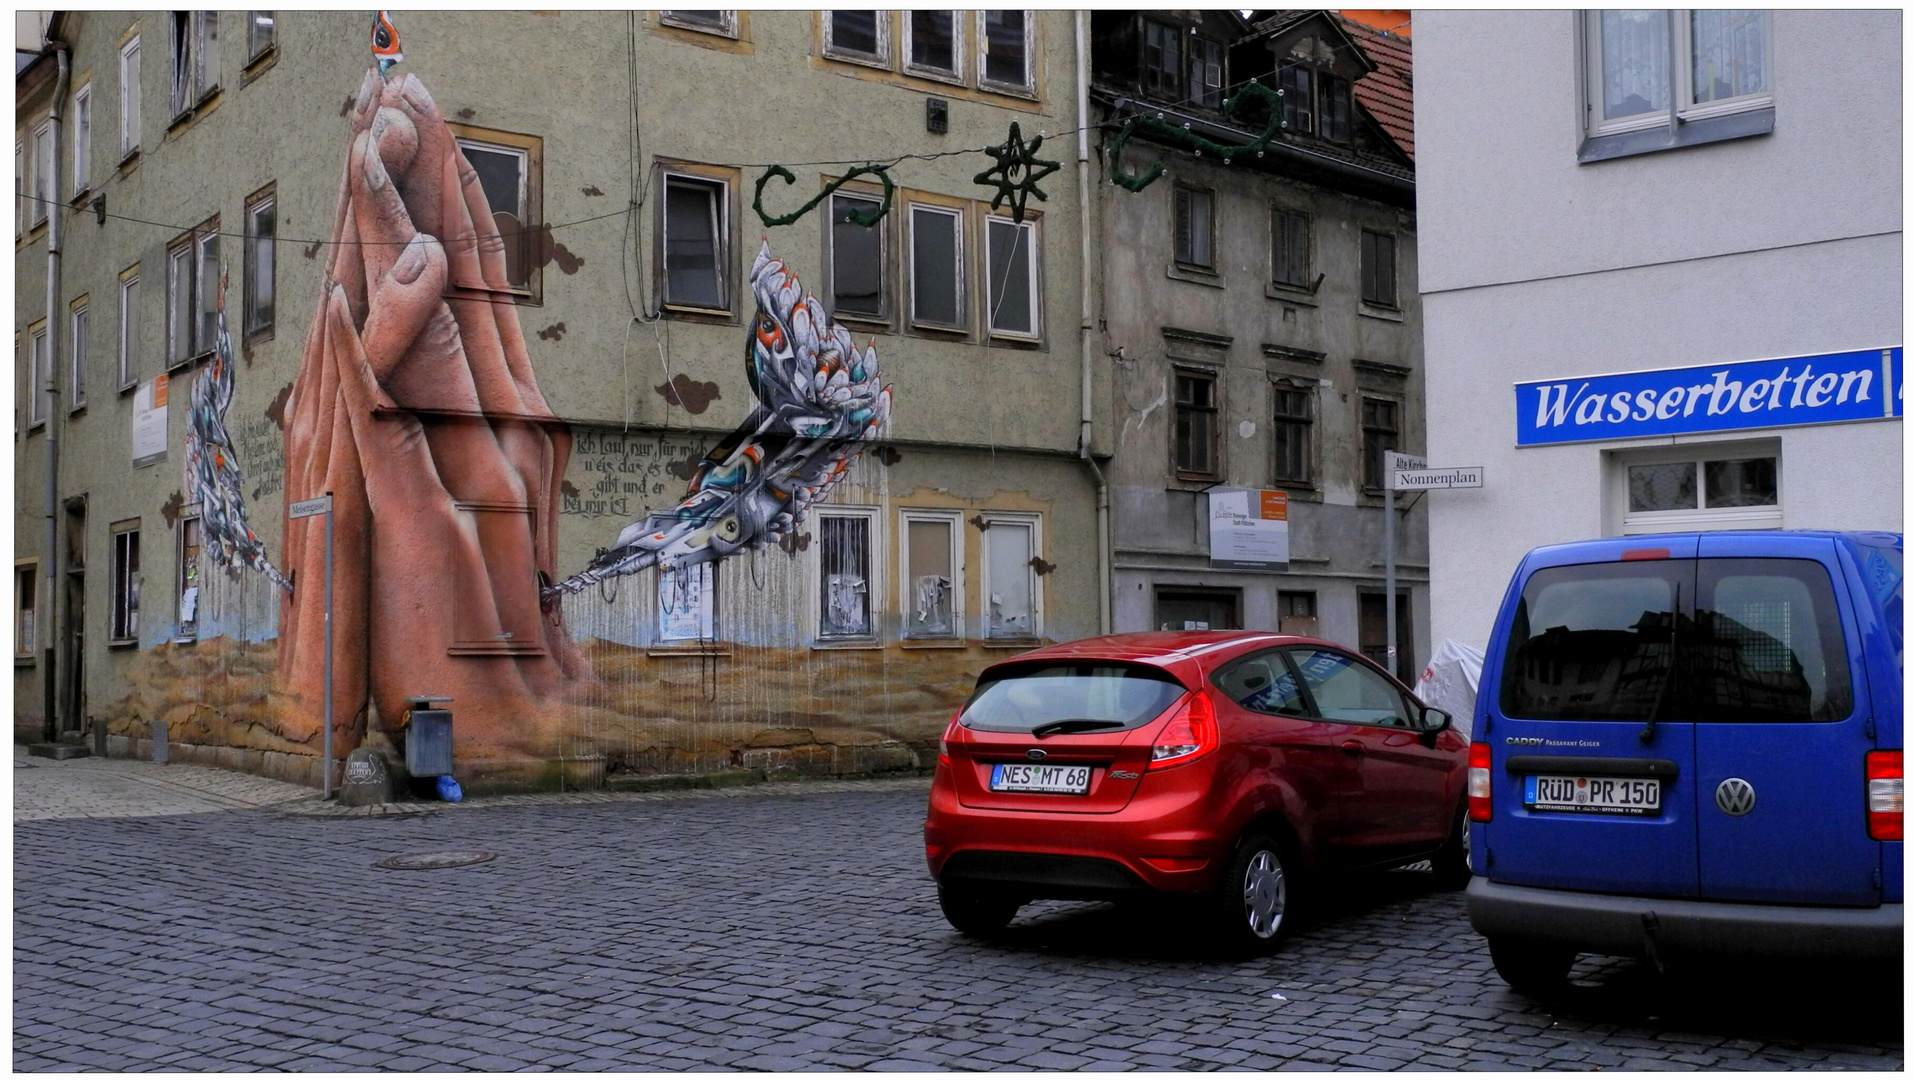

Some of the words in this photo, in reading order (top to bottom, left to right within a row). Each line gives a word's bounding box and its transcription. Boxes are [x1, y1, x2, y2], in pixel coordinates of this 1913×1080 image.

[1535, 363, 1873, 429] Wasserbetten
[1395, 457, 1408, 470] Alte
[1401, 470, 1476, 488] Nonnenplan
[1506, 737, 1544, 746] CADDY
[1001, 766, 1032, 784] NES
[1041, 769, 1063, 785] MT
[1066, 769, 1087, 786] 68
[1538, 779, 1574, 802] RÜD
[1590, 781, 1614, 803] PR
[1620, 782, 1658, 805] 150
